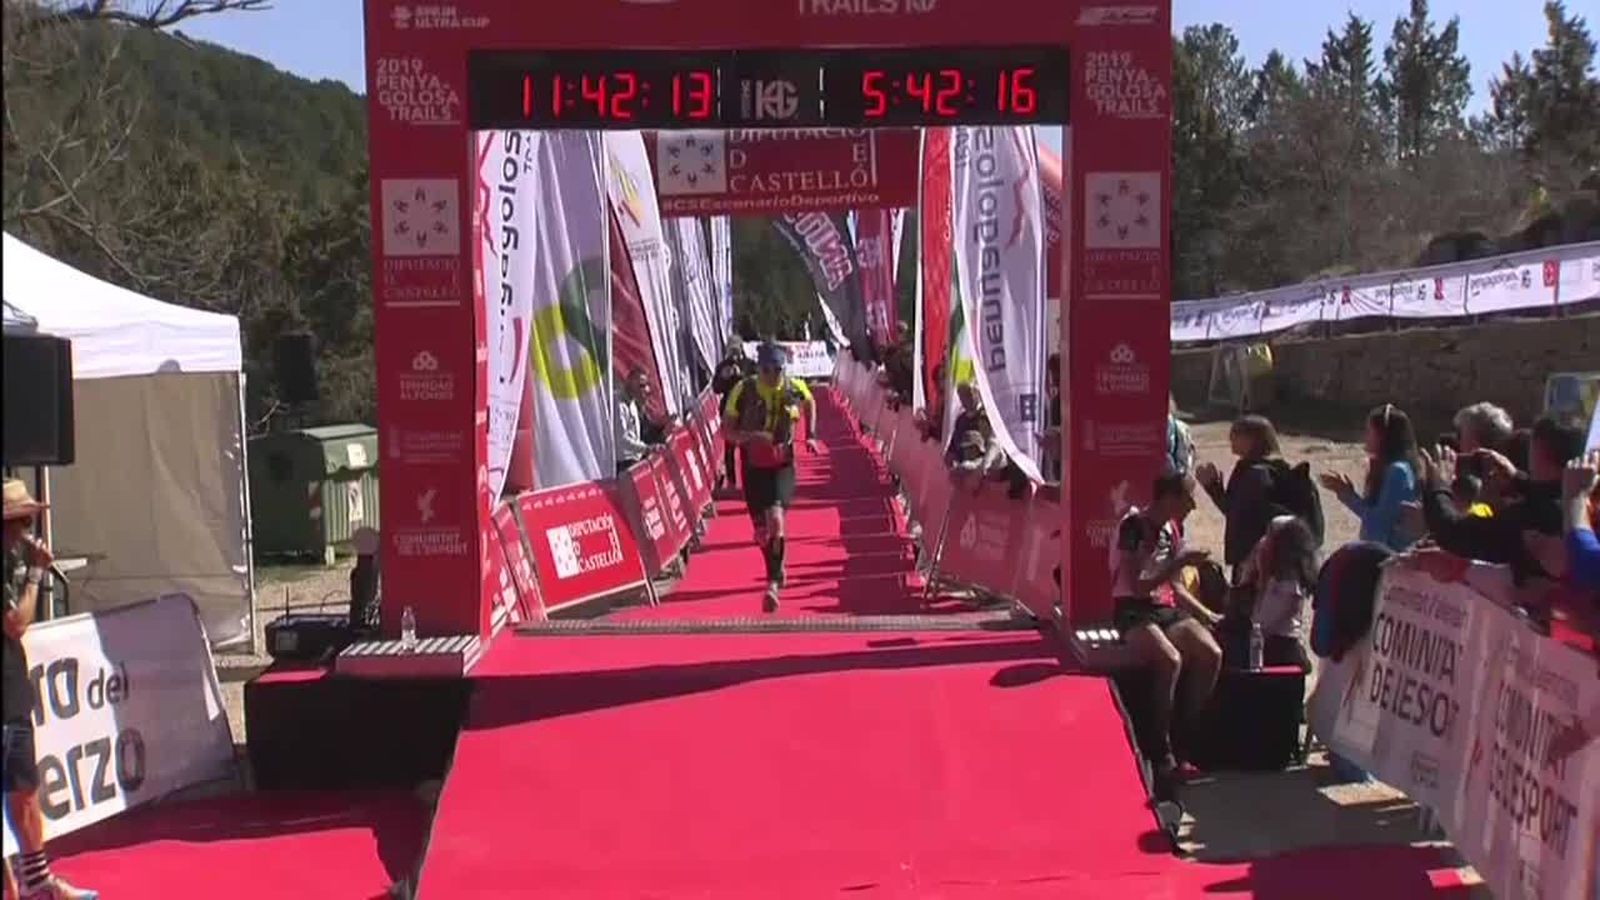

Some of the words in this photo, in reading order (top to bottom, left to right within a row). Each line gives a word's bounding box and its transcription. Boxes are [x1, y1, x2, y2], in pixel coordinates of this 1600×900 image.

[377, 58, 422, 73] 2019
[380, 90, 460, 106] GOLOSA
[523, 72, 713, 119] 11:42:13
[863, 70, 1037, 119] 5:42:16
[389, 106, 451, 121] TRAILS
[1096, 99, 1158, 114] TRAILS
[730, 149, 747, 169] D
[730, 164, 868, 193] CASTELLÓ
[88, 662, 128, 710] del
